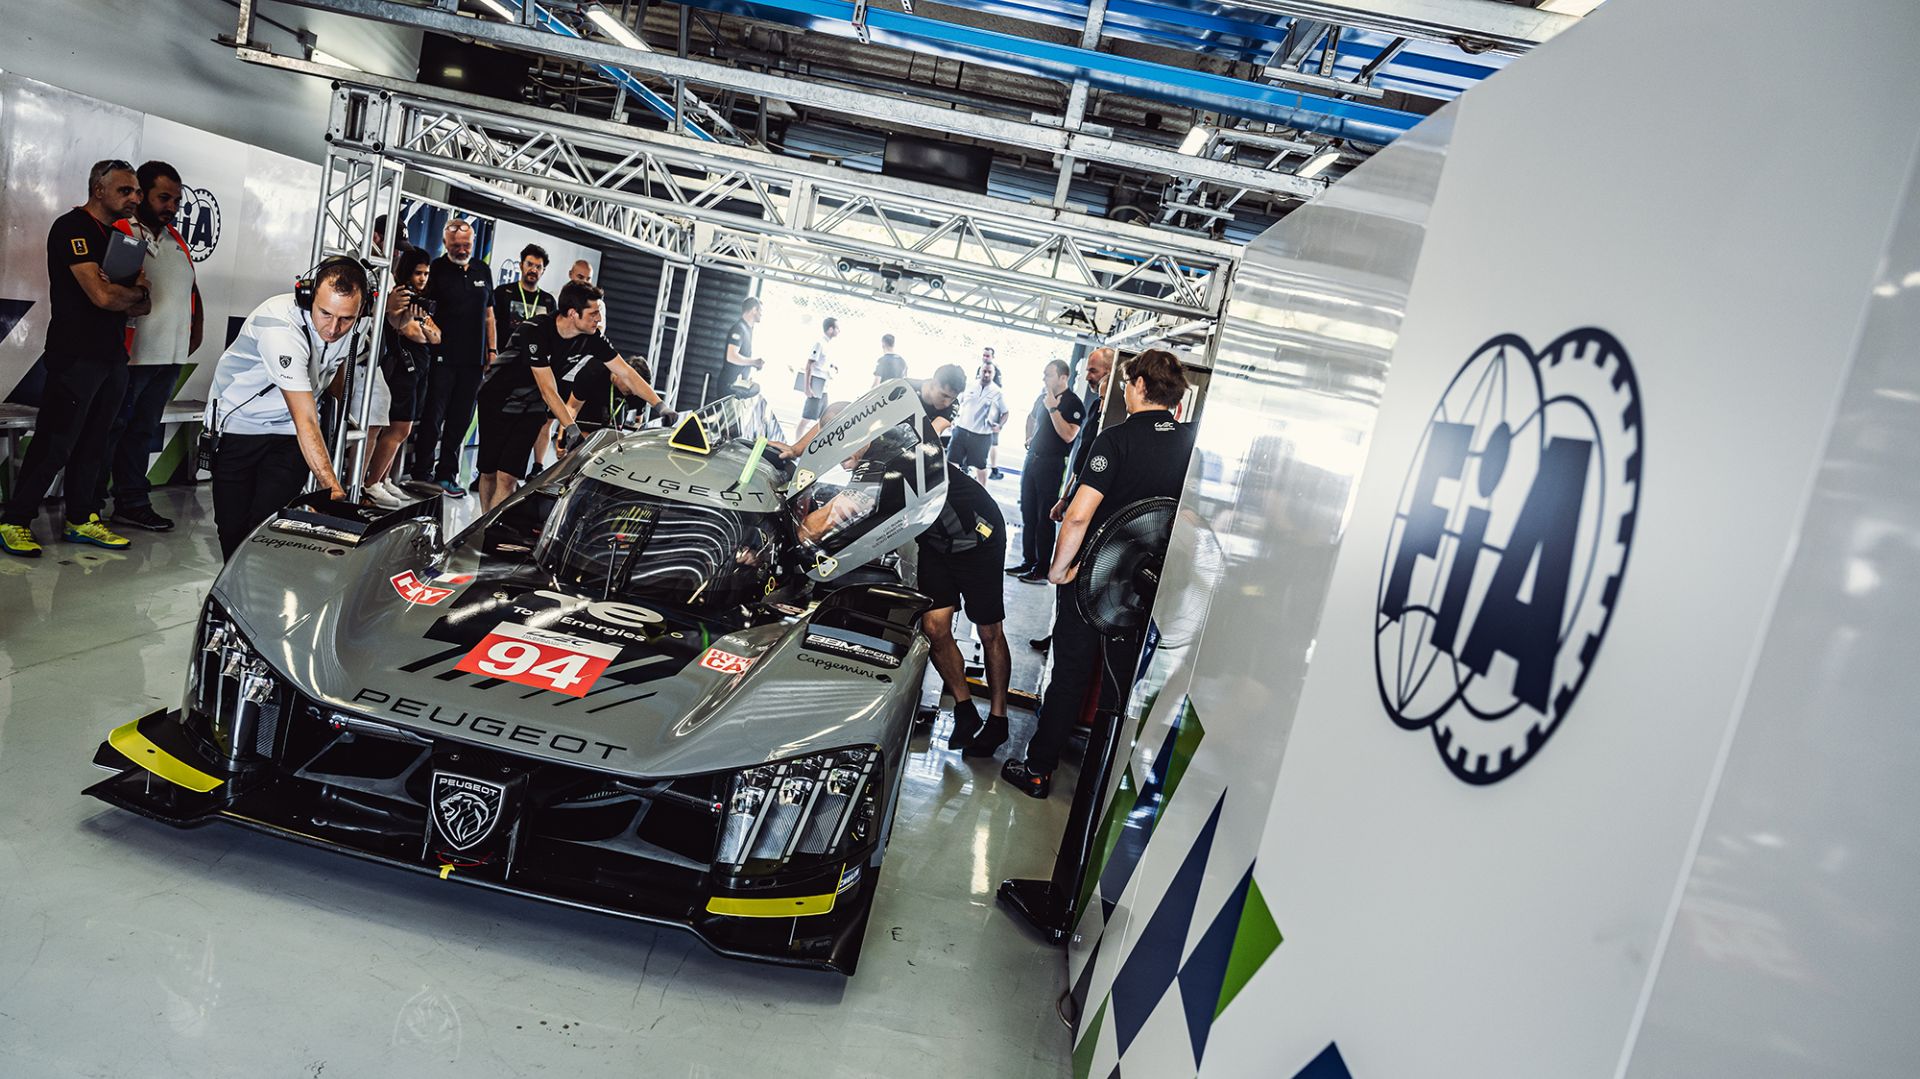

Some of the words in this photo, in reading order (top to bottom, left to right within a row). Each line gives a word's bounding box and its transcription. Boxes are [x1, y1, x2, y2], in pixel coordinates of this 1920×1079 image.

[808, 396, 888, 455] Capgemini
[593, 456, 764, 503] PEUGEOT
[251, 535, 327, 554] Capgemini
[397, 576, 447, 601] HY
[476, 641, 591, 690] 94
[796, 653, 875, 678] Capgemini
[352, 687, 628, 760] PEUGEOT
[439, 777, 498, 797] PEUGEOT
